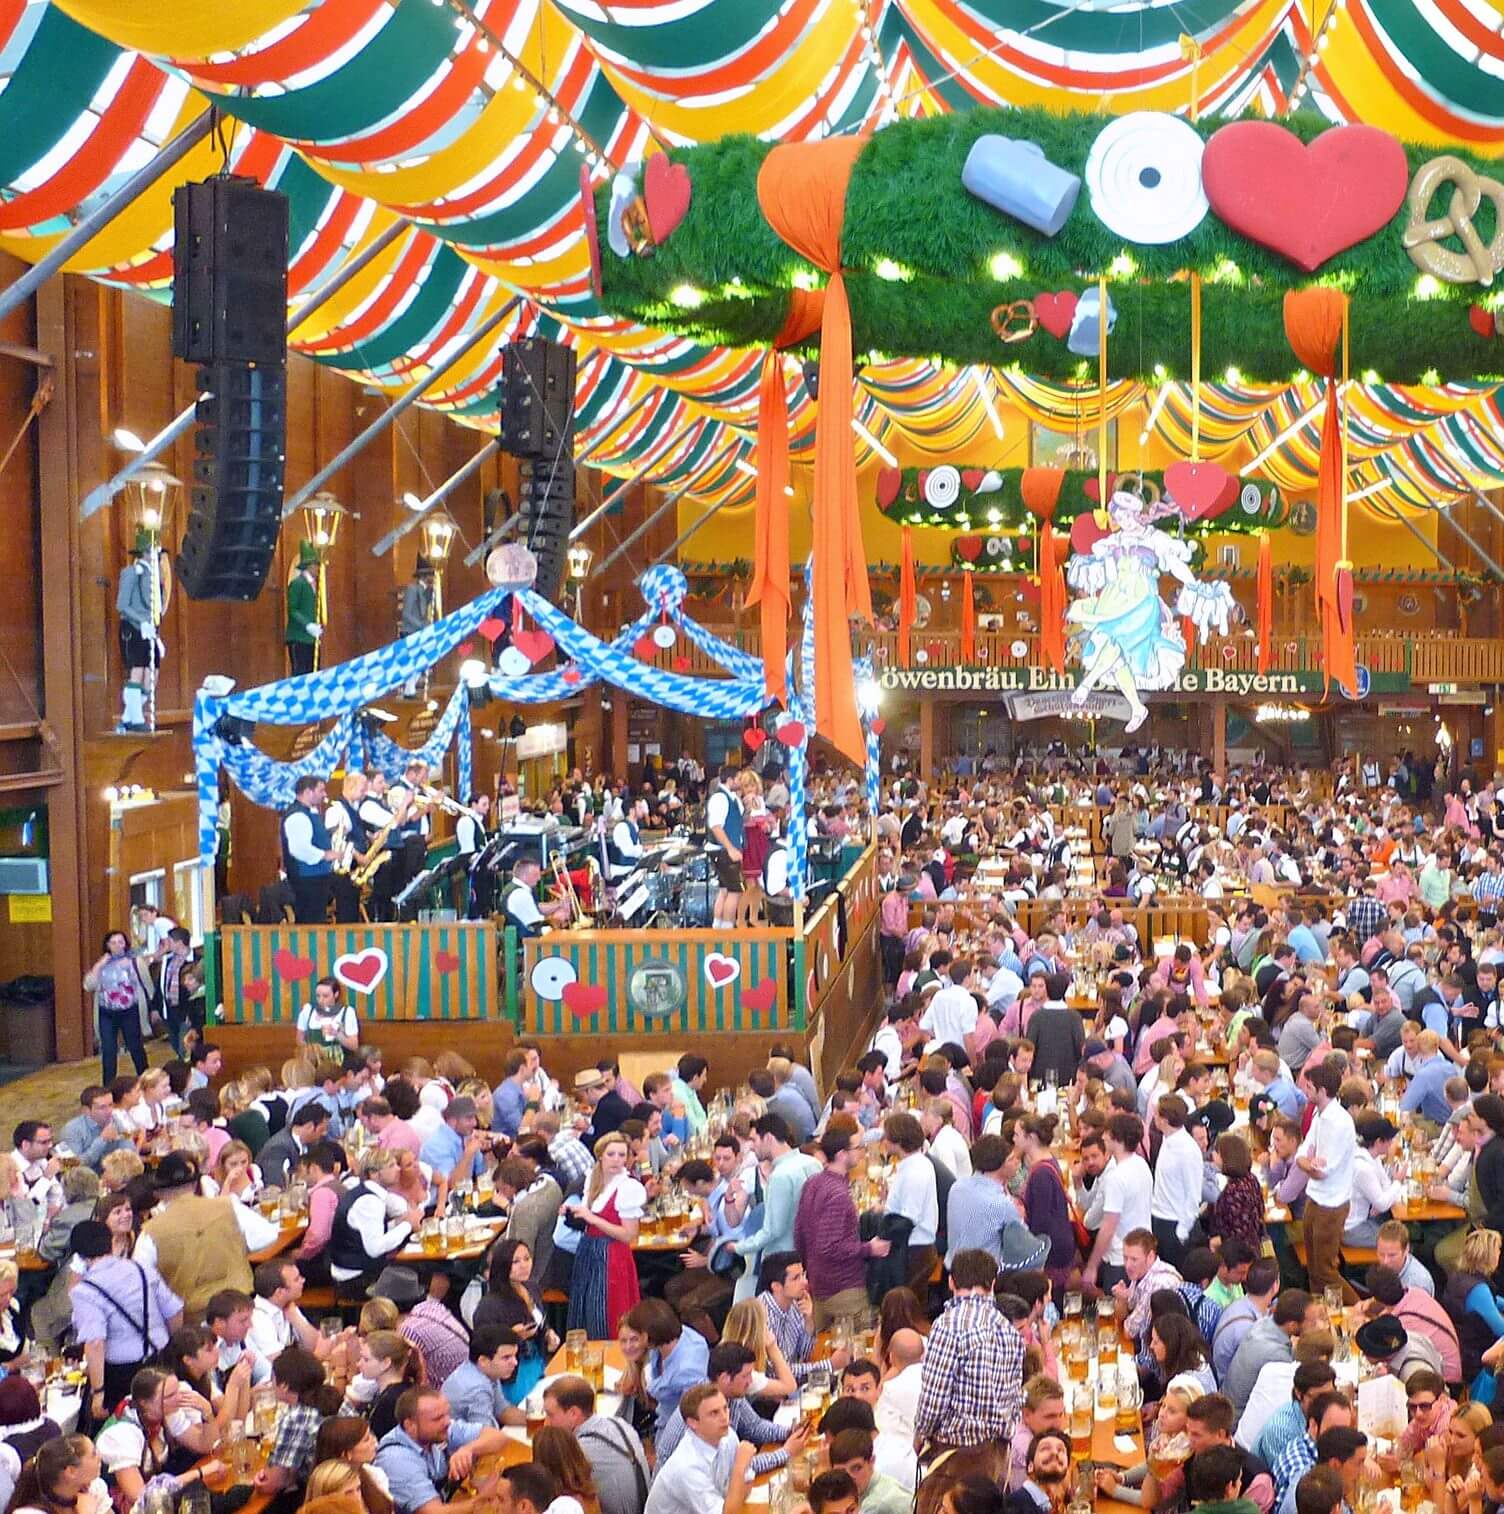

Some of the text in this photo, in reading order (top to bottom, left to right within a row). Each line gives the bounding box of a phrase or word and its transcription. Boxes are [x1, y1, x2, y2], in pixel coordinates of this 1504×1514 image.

[880, 665, 1025, 690] öwenbräu.
[1027, 665, 1076, 691] Ein
[1204, 667, 1307, 696] Bayern.
